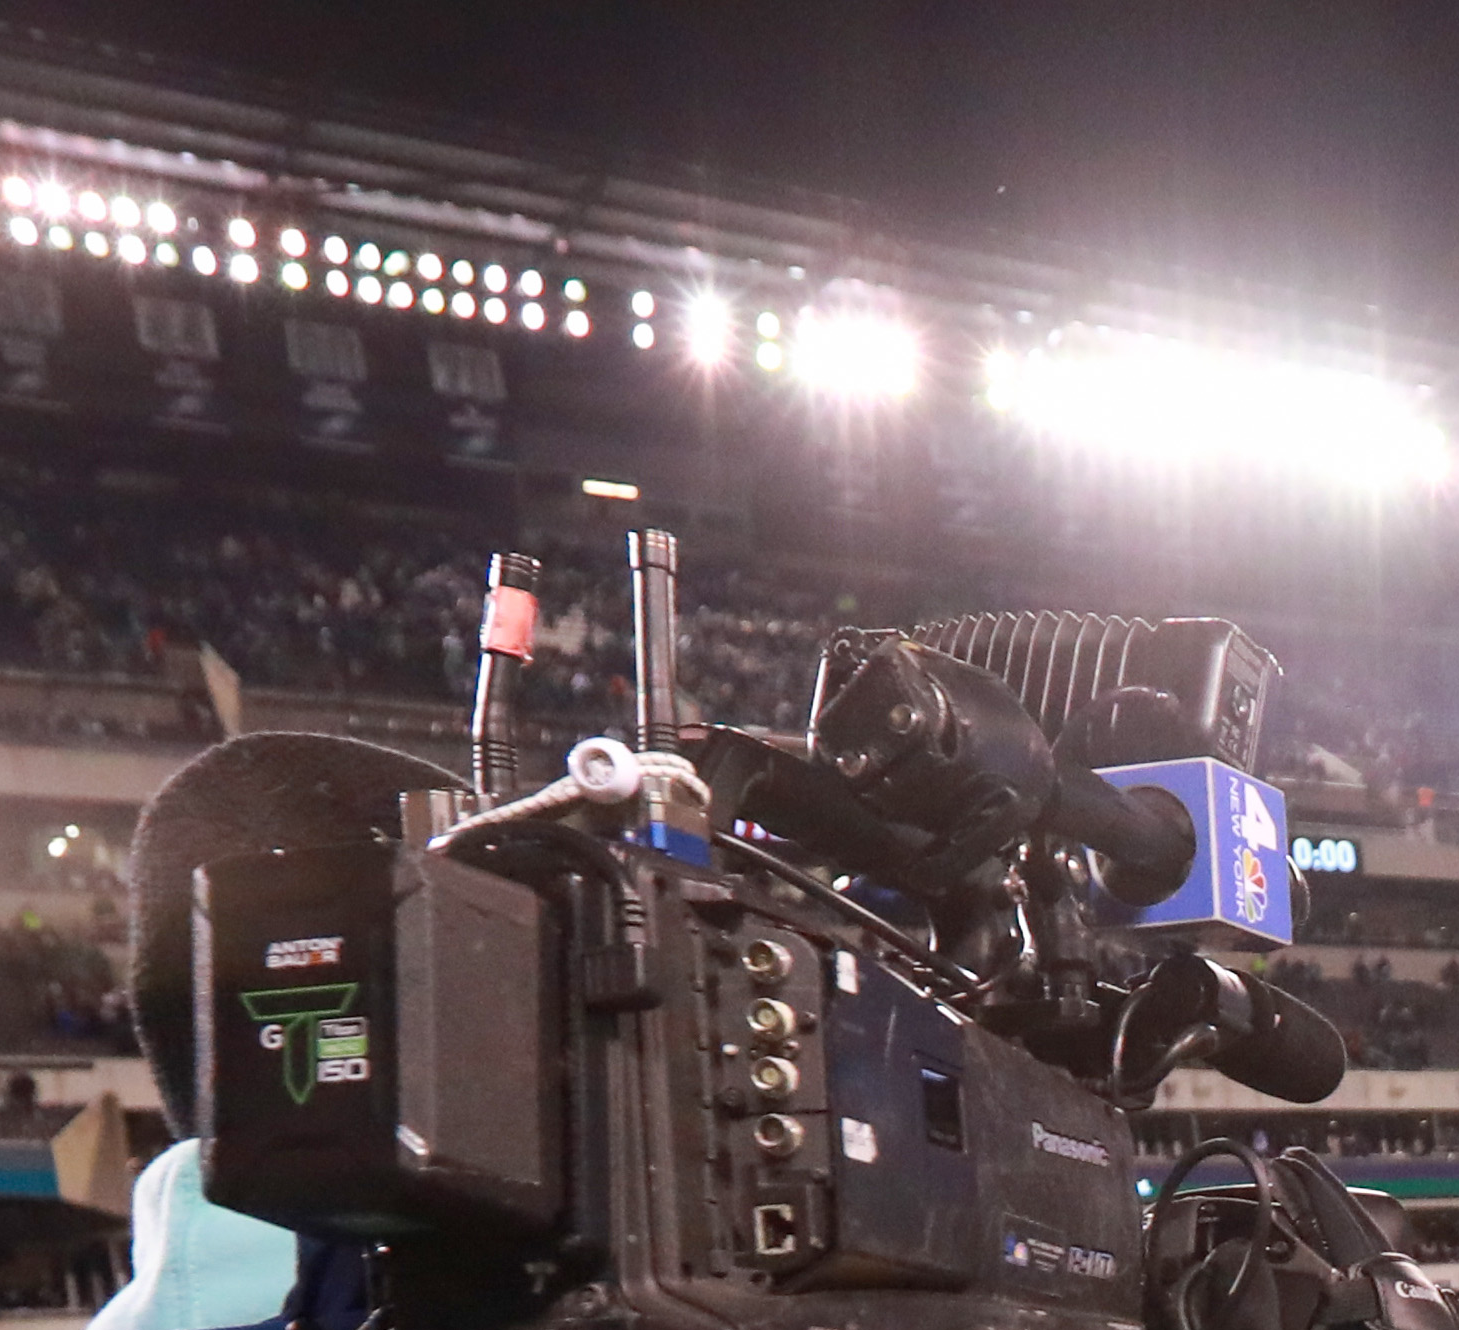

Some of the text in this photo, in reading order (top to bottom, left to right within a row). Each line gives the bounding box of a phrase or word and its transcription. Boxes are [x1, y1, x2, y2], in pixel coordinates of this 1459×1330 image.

[1241, 783, 1277, 851] 4
[1229, 776, 1246, 917] NEW YORK
[1293, 837, 1357, 873] 0:00
[266, 936, 343, 954] ANTON
[1031, 1120, 1111, 1168] Panasonic
